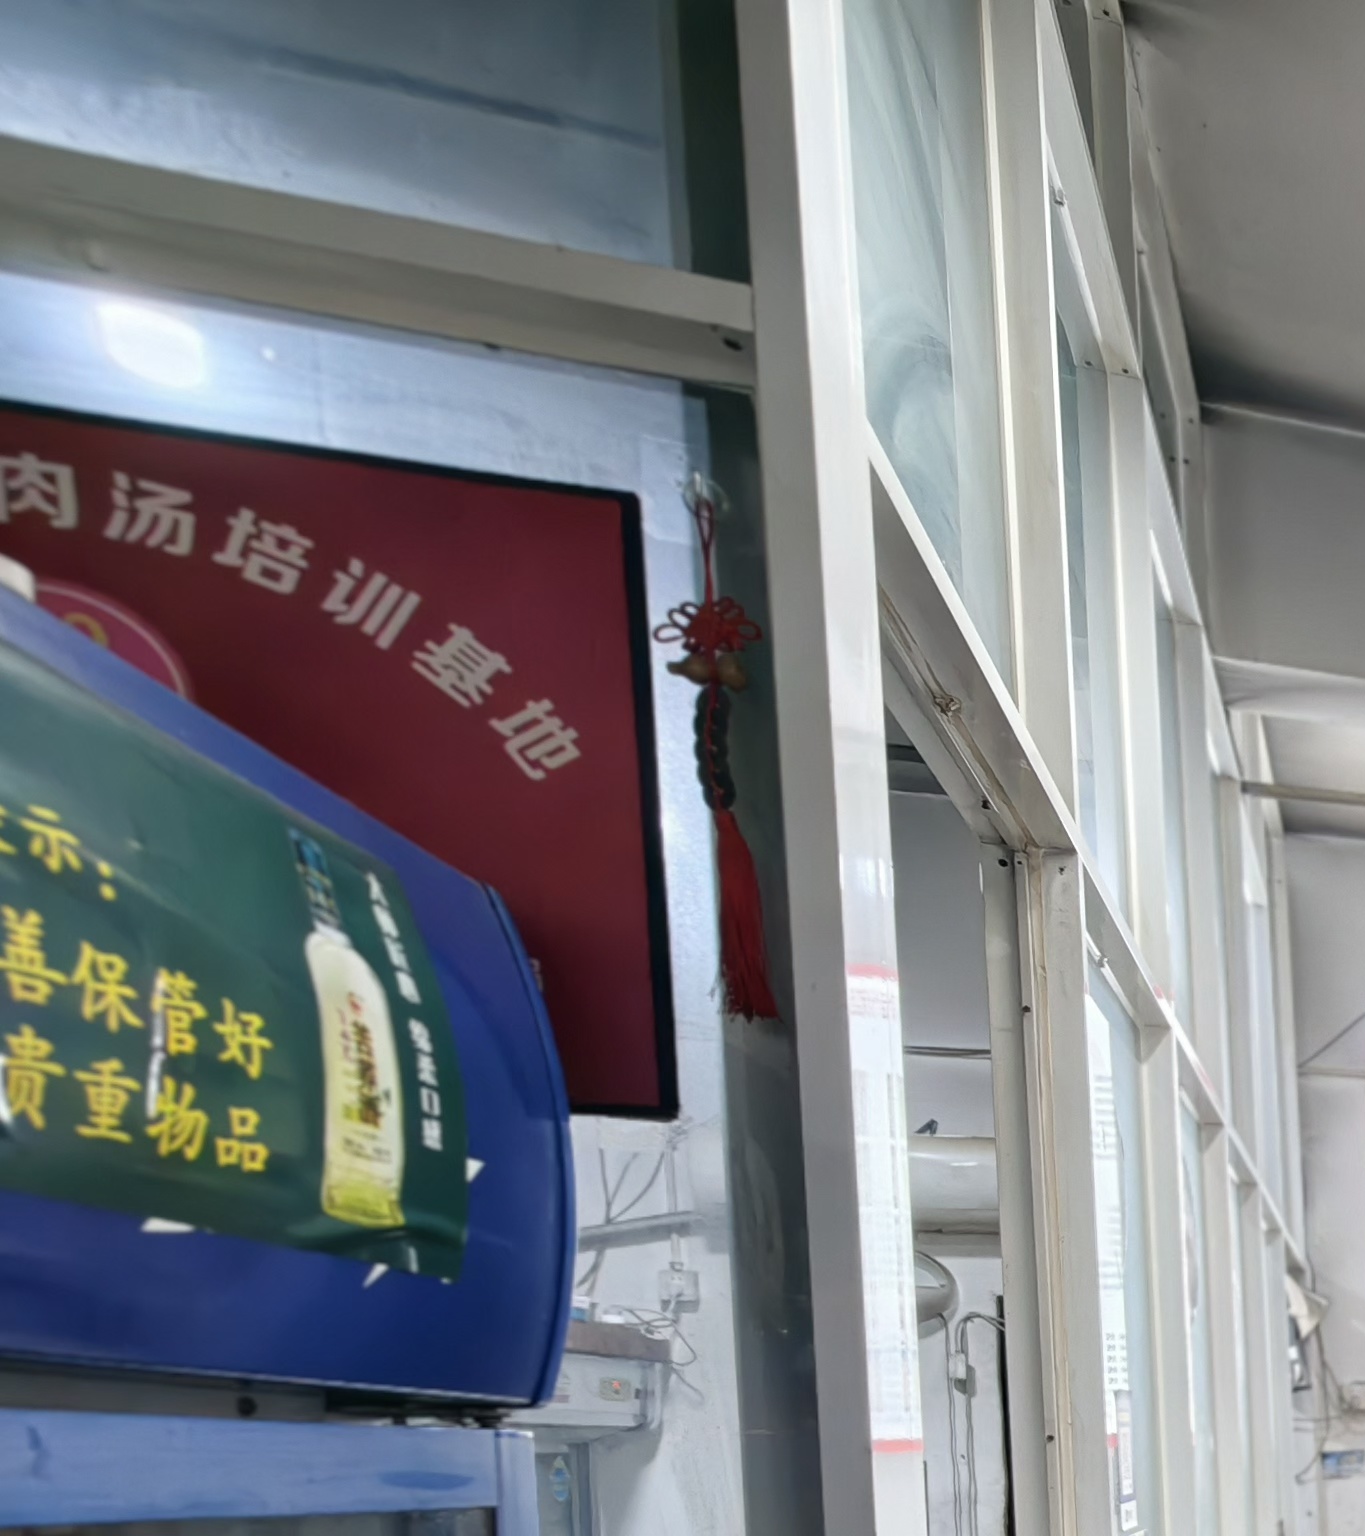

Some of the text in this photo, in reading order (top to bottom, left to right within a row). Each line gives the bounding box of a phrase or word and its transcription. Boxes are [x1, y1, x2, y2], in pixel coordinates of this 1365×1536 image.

[0, 452, 582, 781] 肉汤培训基地
[0, 803, 117, 900] 示：
[0, 905, 273, 1080] 善保管好
[3, 1024, 270, 1172] 贵重物品
